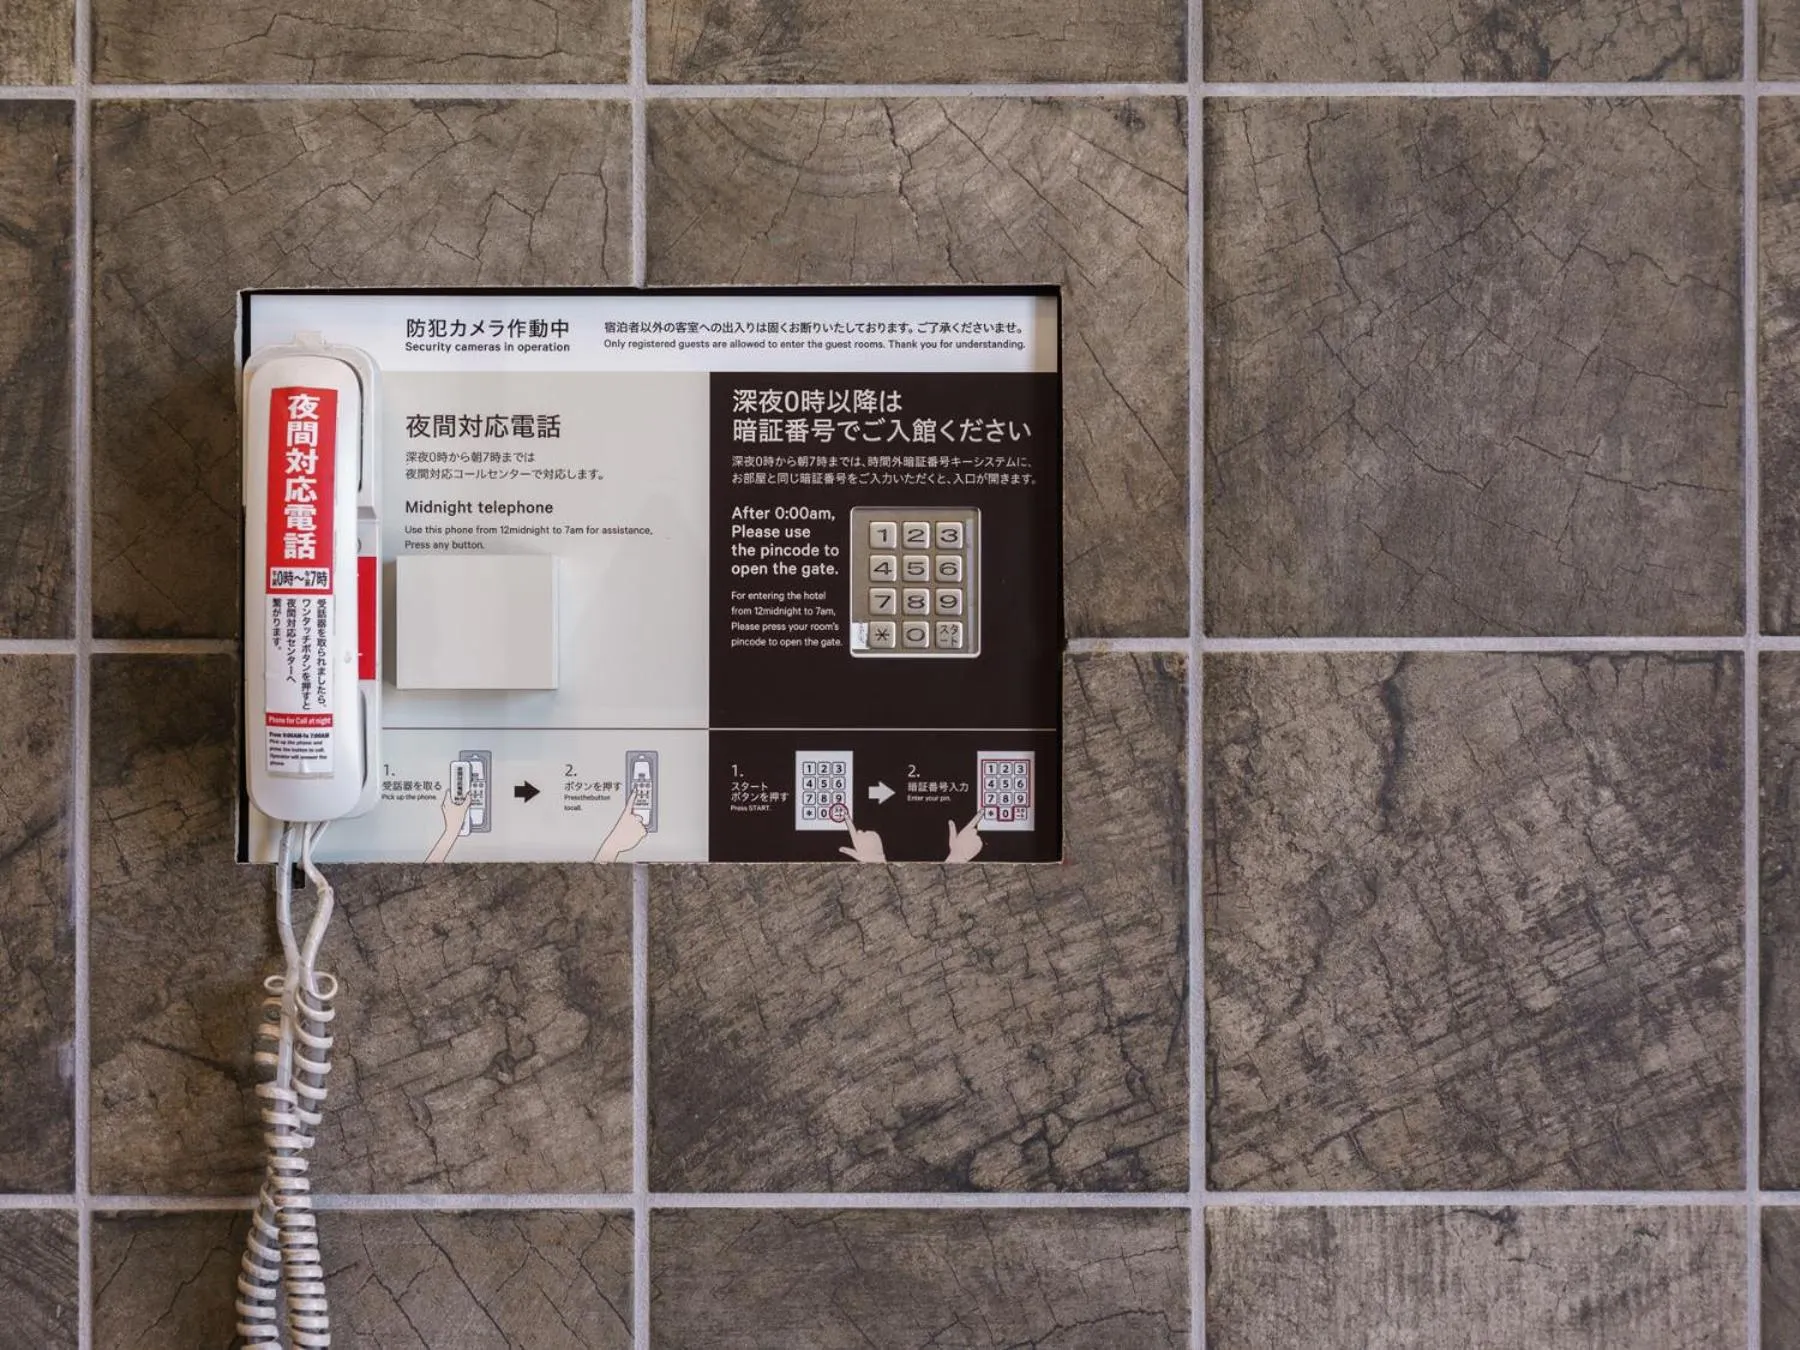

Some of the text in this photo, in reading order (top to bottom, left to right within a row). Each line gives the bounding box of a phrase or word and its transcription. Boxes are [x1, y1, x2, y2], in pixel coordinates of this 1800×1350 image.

[407, 319, 568, 338] 防犯カメラ作動中
[405, 342, 570, 353] Security cameras in operation
[604, 339, 626, 349] Only
[628, 340, 676, 349] registered
[679, 341, 709, 350] guests
[730, 340, 765, 348] allowed
[807, 340, 822, 348] the
[825, 341, 851, 350] guest
[888, 340, 917, 348] Thank
[920, 342, 937, 350] you
[940, 339, 953, 348] for
[956, 340, 1025, 350] understanding.
[733, 389, 902, 413] 深夜0時以降は
[406, 414, 560, 438] 夜間対応電話
[734, 417, 1031, 443] 暗証番号でご入館ください
[406, 451, 534, 465] 深夜0時から朝7時までは
[732, 455, 1032, 468] 深夜0時から朝7時までは、時間外暗証番号キーシステムに、
[283, 393, 320, 560] 夜間対応電話
[406, 468, 603, 480] 夜間対応コールセンターで対応します。
[732, 472, 1037, 485] お部屋と同じ暗証番号をご入力いただくと、入口が開きます。
[406, 500, 553, 516] Midnight telephone
[732, 506, 835, 521] After 0:00am,
[405, 526, 422, 534] Use
[445, 526, 473, 535] phone
[476, 525, 497, 534] from
[500, 526, 549, 536] 12midnight
[565, 526, 583, 534] 7am
[586, 526, 599, 534] for
[732, 524, 810, 538] Please use
[877, 528, 958, 542] 1 2 3
[405, 540, 484, 550] Press any button.
[732, 543, 839, 559] the pincode to
[732, 562, 838, 578] open the gate.
[873, 562, 958, 576] 4 5 6
[732, 591, 826, 602] For entering the hotel
[875, 595, 958, 609] 7 8 9
[731, 606, 751, 615] from
[754, 607, 801, 617] 12midnight
[816, 607, 835, 616] 7am,
[732, 622, 839, 632] Please press your room's
[731, 638, 842, 648] pincode to open the gate.
[384, 764, 395, 776] 1.
[565, 764, 577, 777] 2.
[732, 764, 743, 777] 1.
[807, 765, 842, 773] 1 2 3
[908, 764, 920, 777] 2.
[988, 765, 1024, 773] 1 2 3
[382, 780, 442, 791] 受話器を取る
[565, 781, 621, 791] ボタンを押す
[732, 782, 768, 791] スタート
[806, 780, 842, 788] 4 5 6
[908, 782, 968, 792] 暗証番号入力
[988, 780, 1024, 788] 4 5 6
[732, 792, 788, 802] ボタンを押す
[806, 794, 842, 803] 7 8 9
[988, 794, 1024, 803] 7 8 9
[821, 809, 827, 817] 0
[1003, 809, 1009, 817] 0
